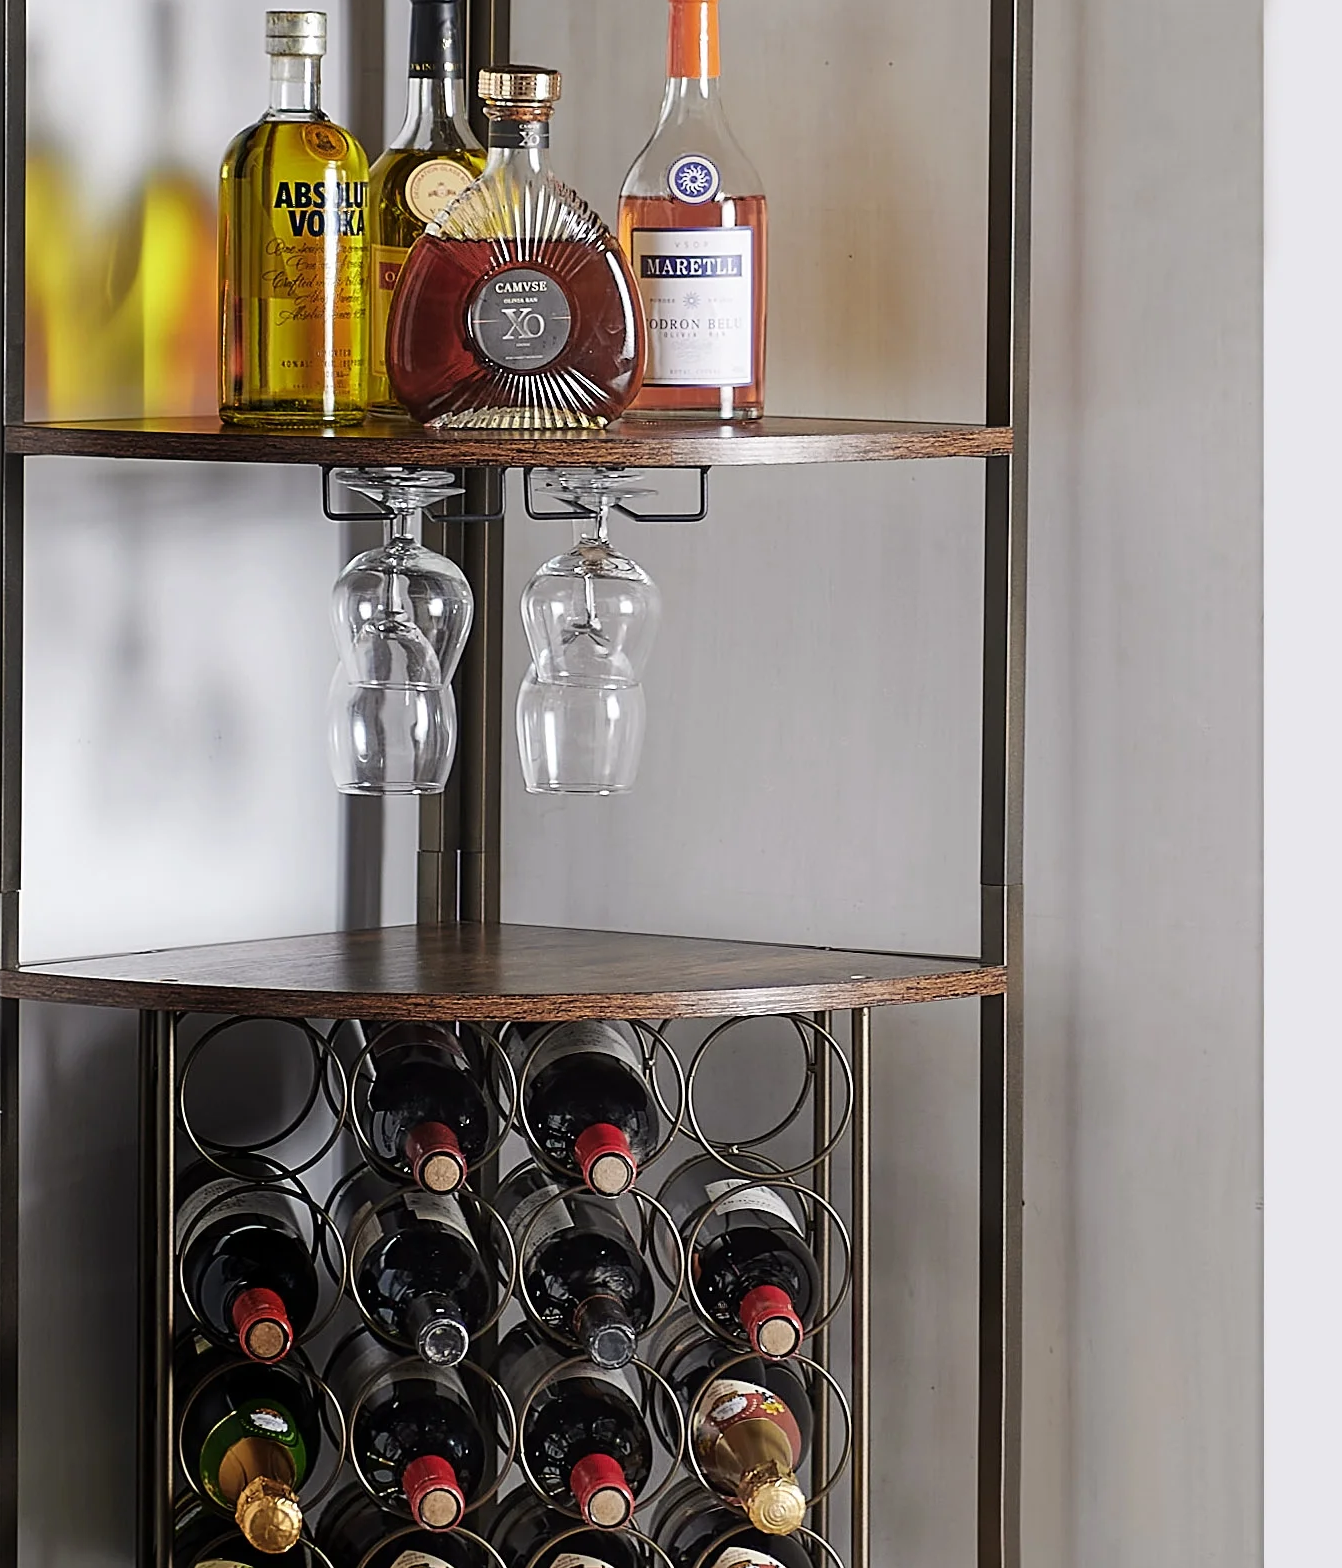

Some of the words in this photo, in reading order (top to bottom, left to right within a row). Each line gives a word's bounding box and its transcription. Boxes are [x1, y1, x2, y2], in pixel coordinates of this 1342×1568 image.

[519, 131, 541, 146] XO
[647, 257, 738, 275] MARETLL
[495, 280, 548, 293] CAMVSE
[501, 307, 545, 340] XO
[646, 318, 700, 330] ODRON
